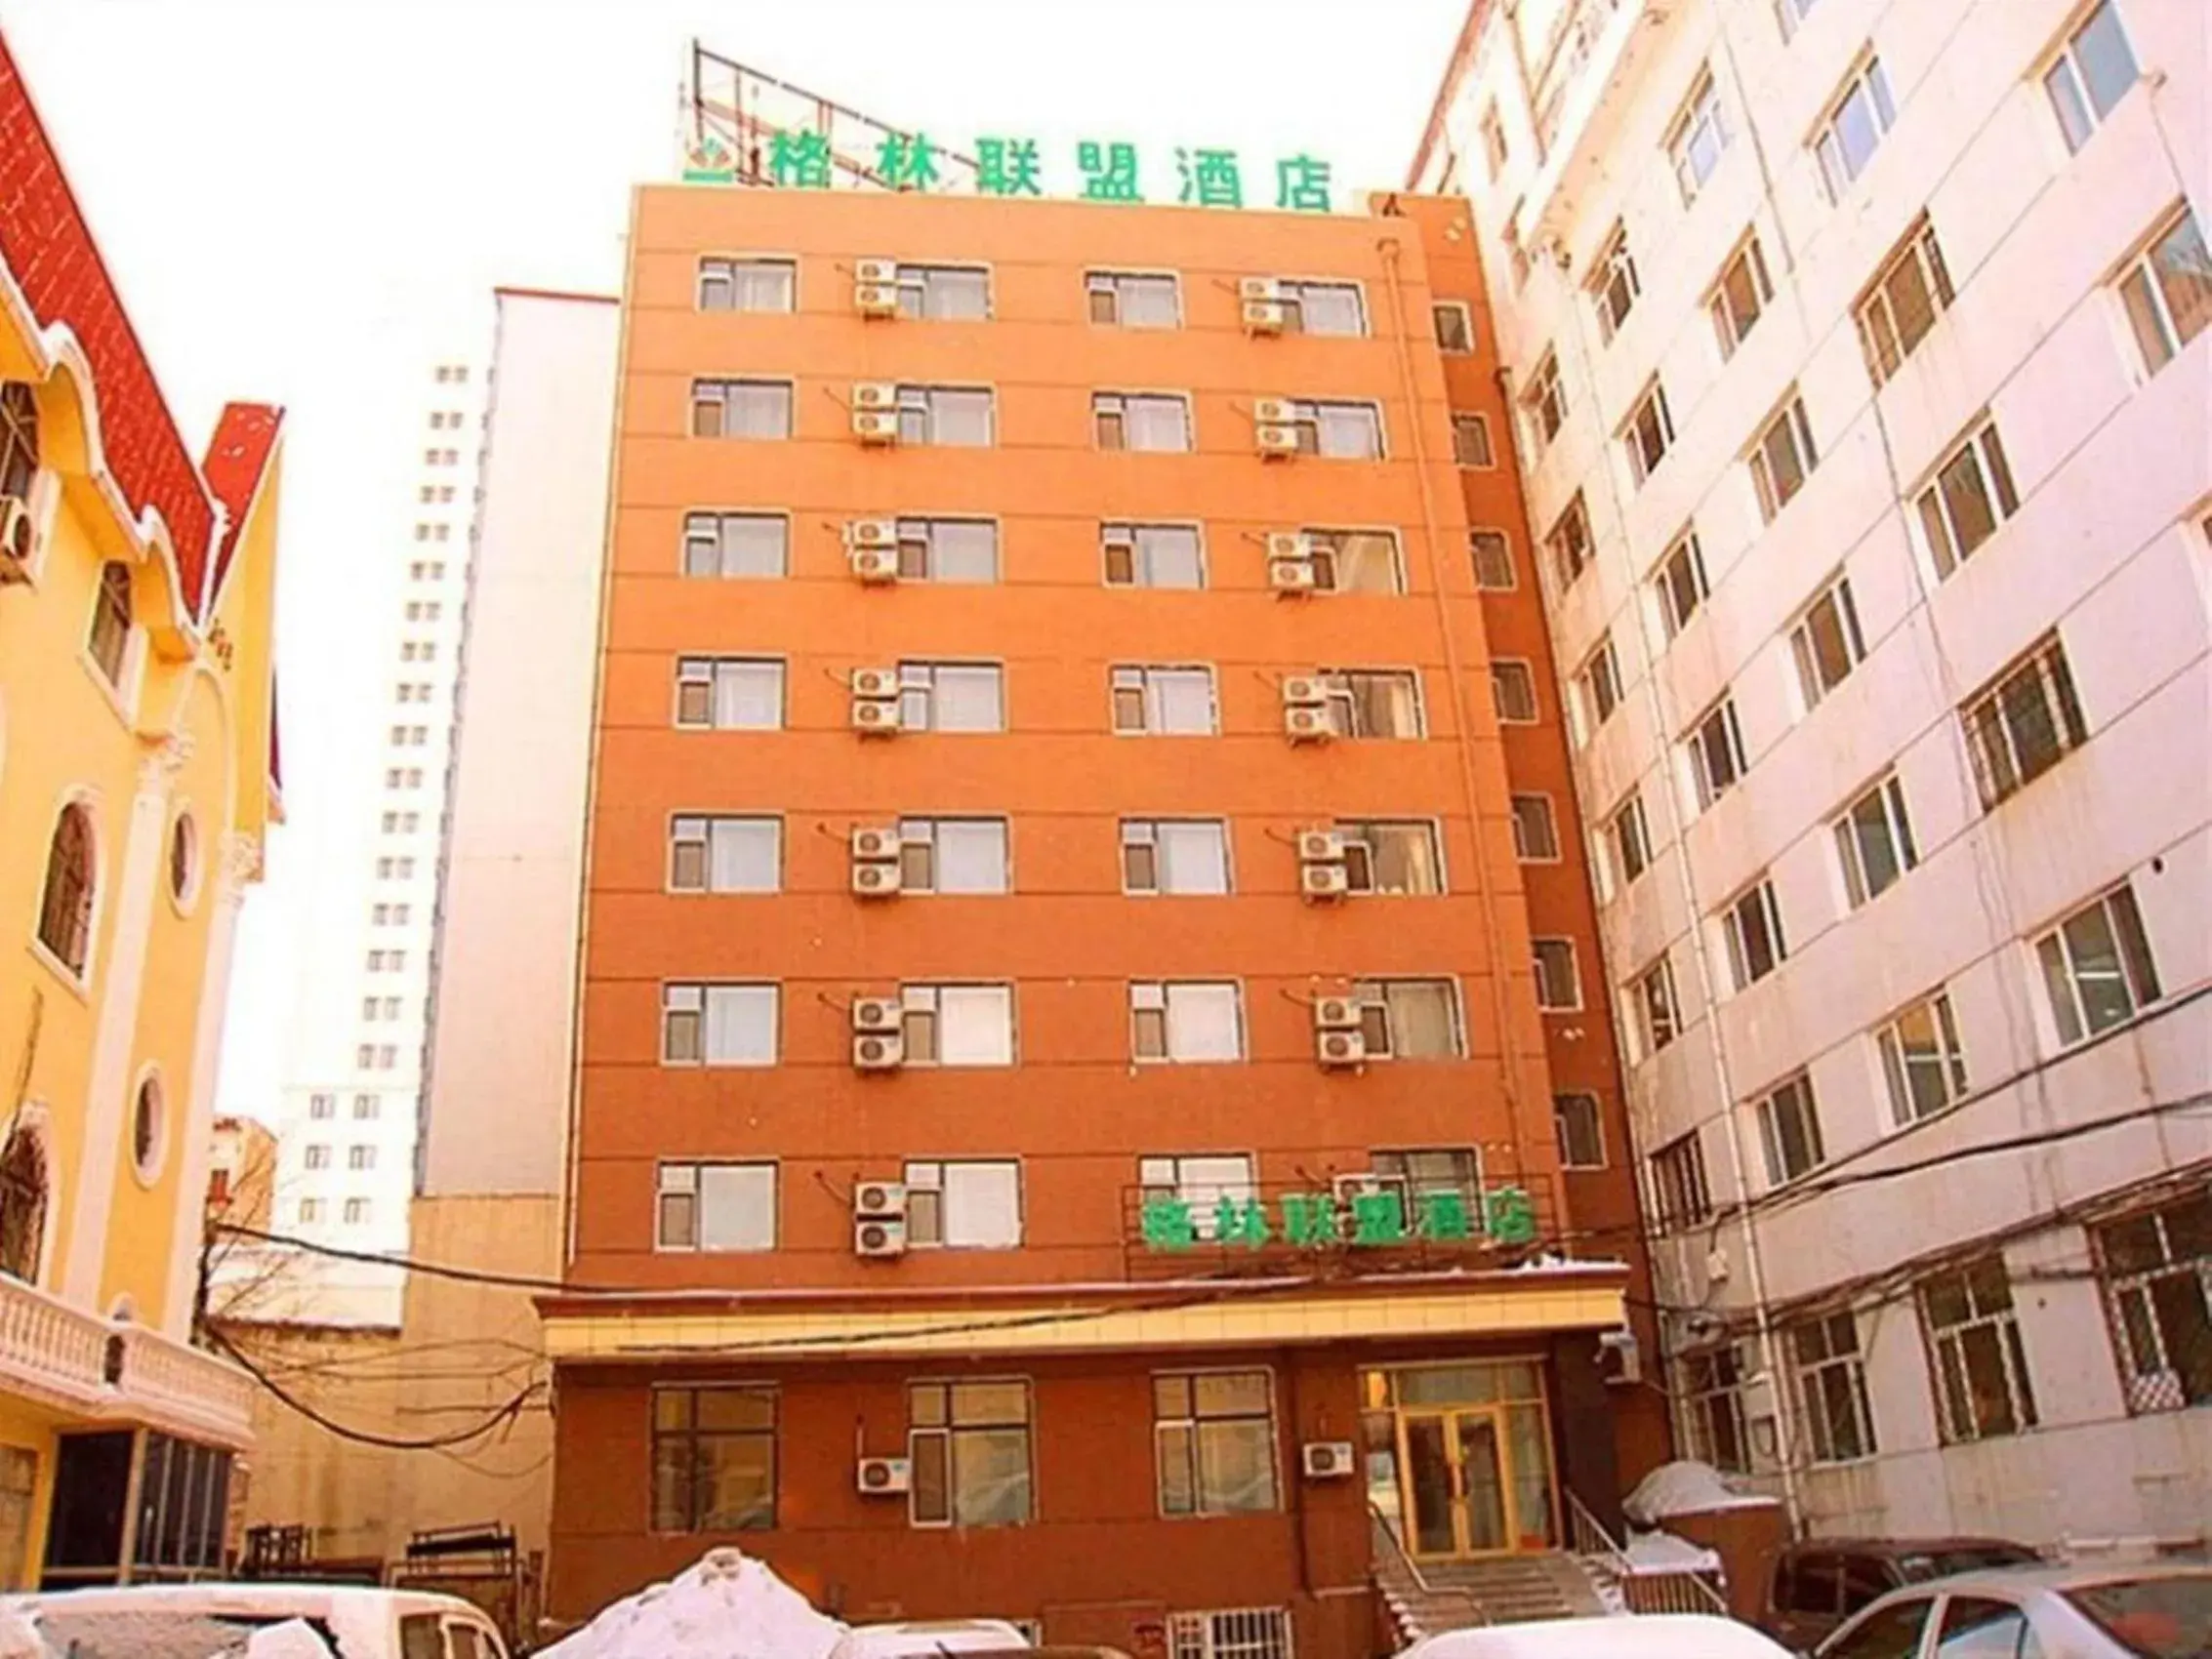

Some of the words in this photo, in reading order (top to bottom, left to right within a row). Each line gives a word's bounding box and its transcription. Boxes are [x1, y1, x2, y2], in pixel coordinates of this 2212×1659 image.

[767, 128, 1334, 213] 格林联盟酒店
